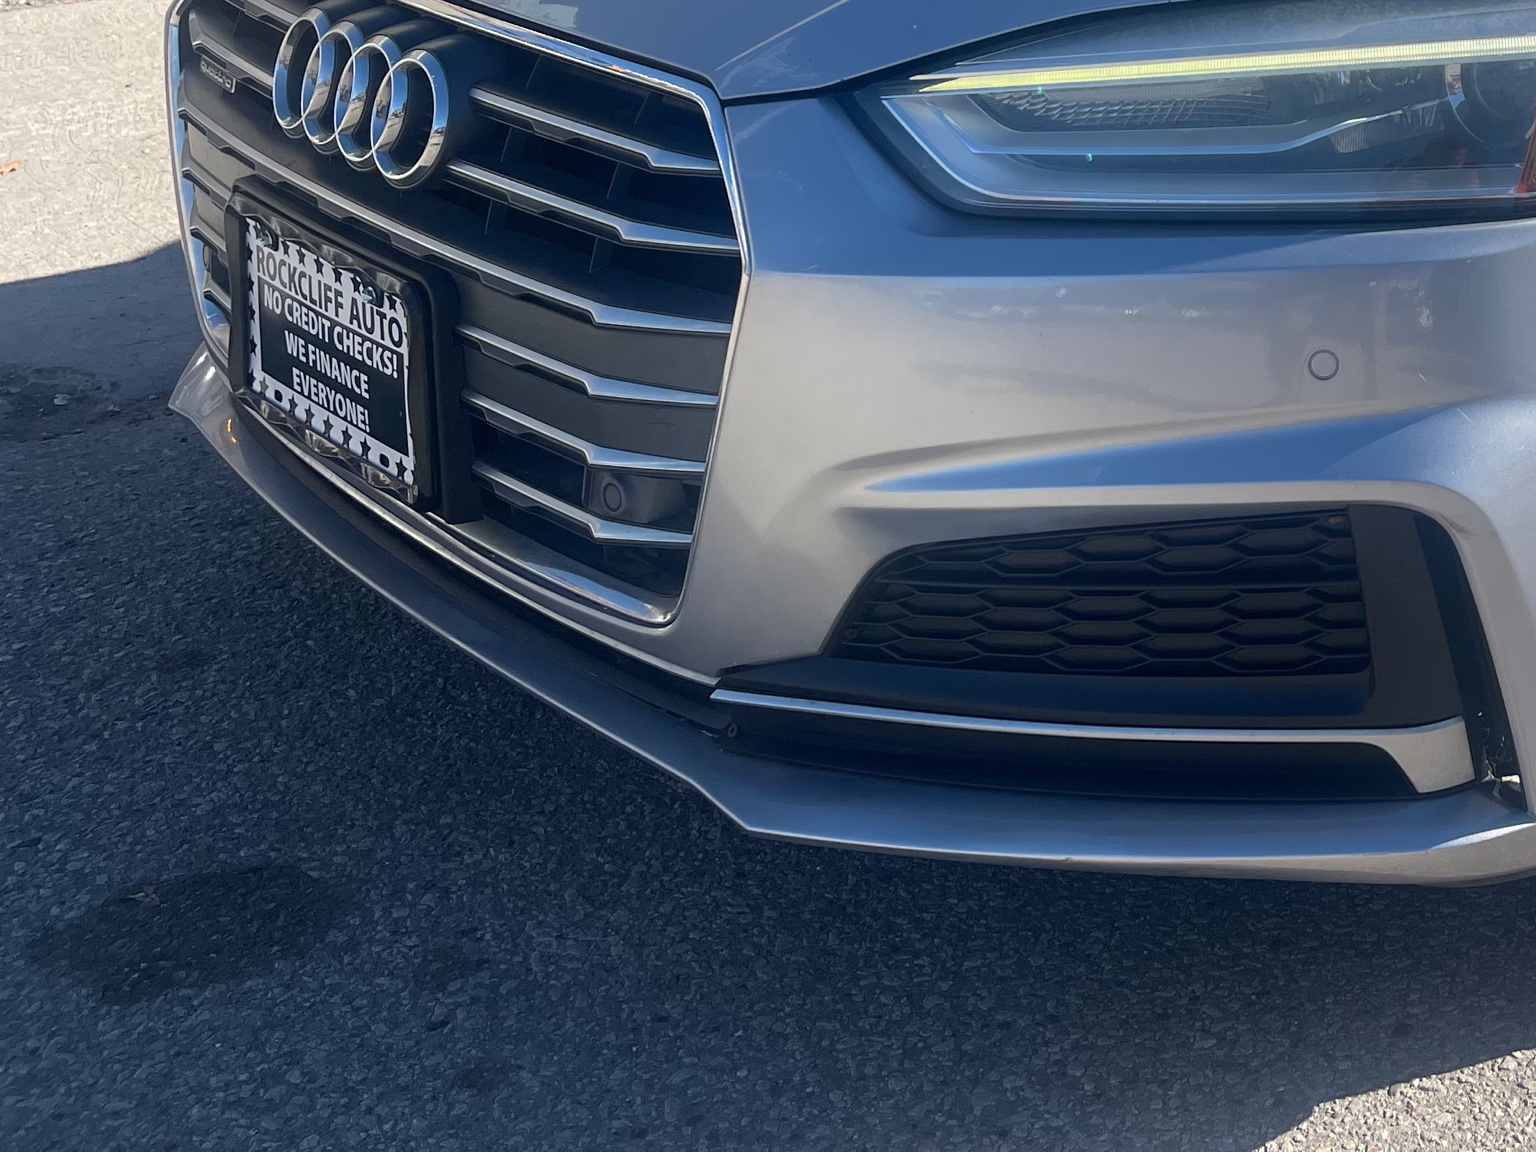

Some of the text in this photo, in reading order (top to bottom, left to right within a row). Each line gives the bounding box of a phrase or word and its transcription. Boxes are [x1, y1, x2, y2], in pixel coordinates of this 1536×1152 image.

[256, 245, 404, 349] ROCKCLIFF AUTO
[263, 283, 399, 379] NO CREDIT CHECKS!
[284, 329, 370, 399] WE FINANCE
[291, 366, 371, 433] EVERYONE!
